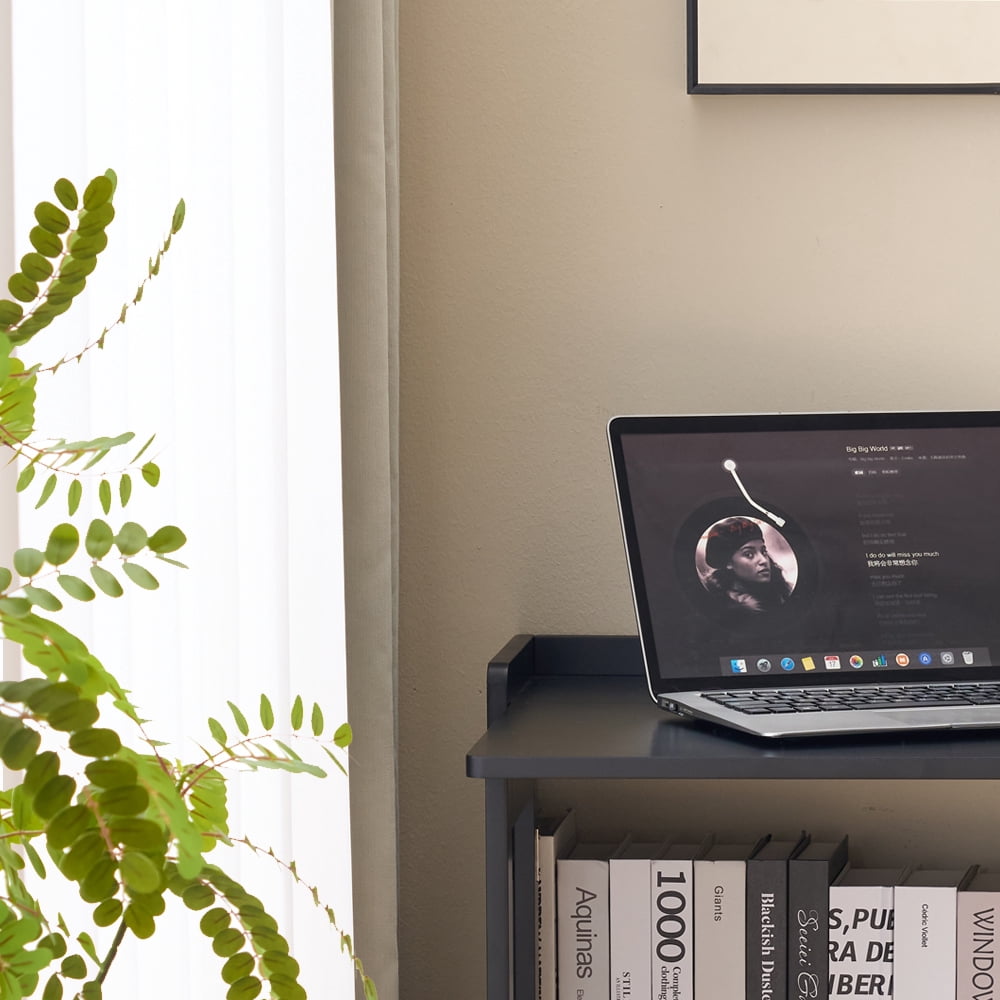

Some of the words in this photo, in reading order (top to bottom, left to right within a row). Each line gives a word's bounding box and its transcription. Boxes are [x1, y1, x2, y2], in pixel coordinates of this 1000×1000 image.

[570, 886, 598, 979] Aquinas
[656, 871, 686, 963] 1000
[714, 885, 724, 922] Giants
[761, 893, 775, 955] Blackish
